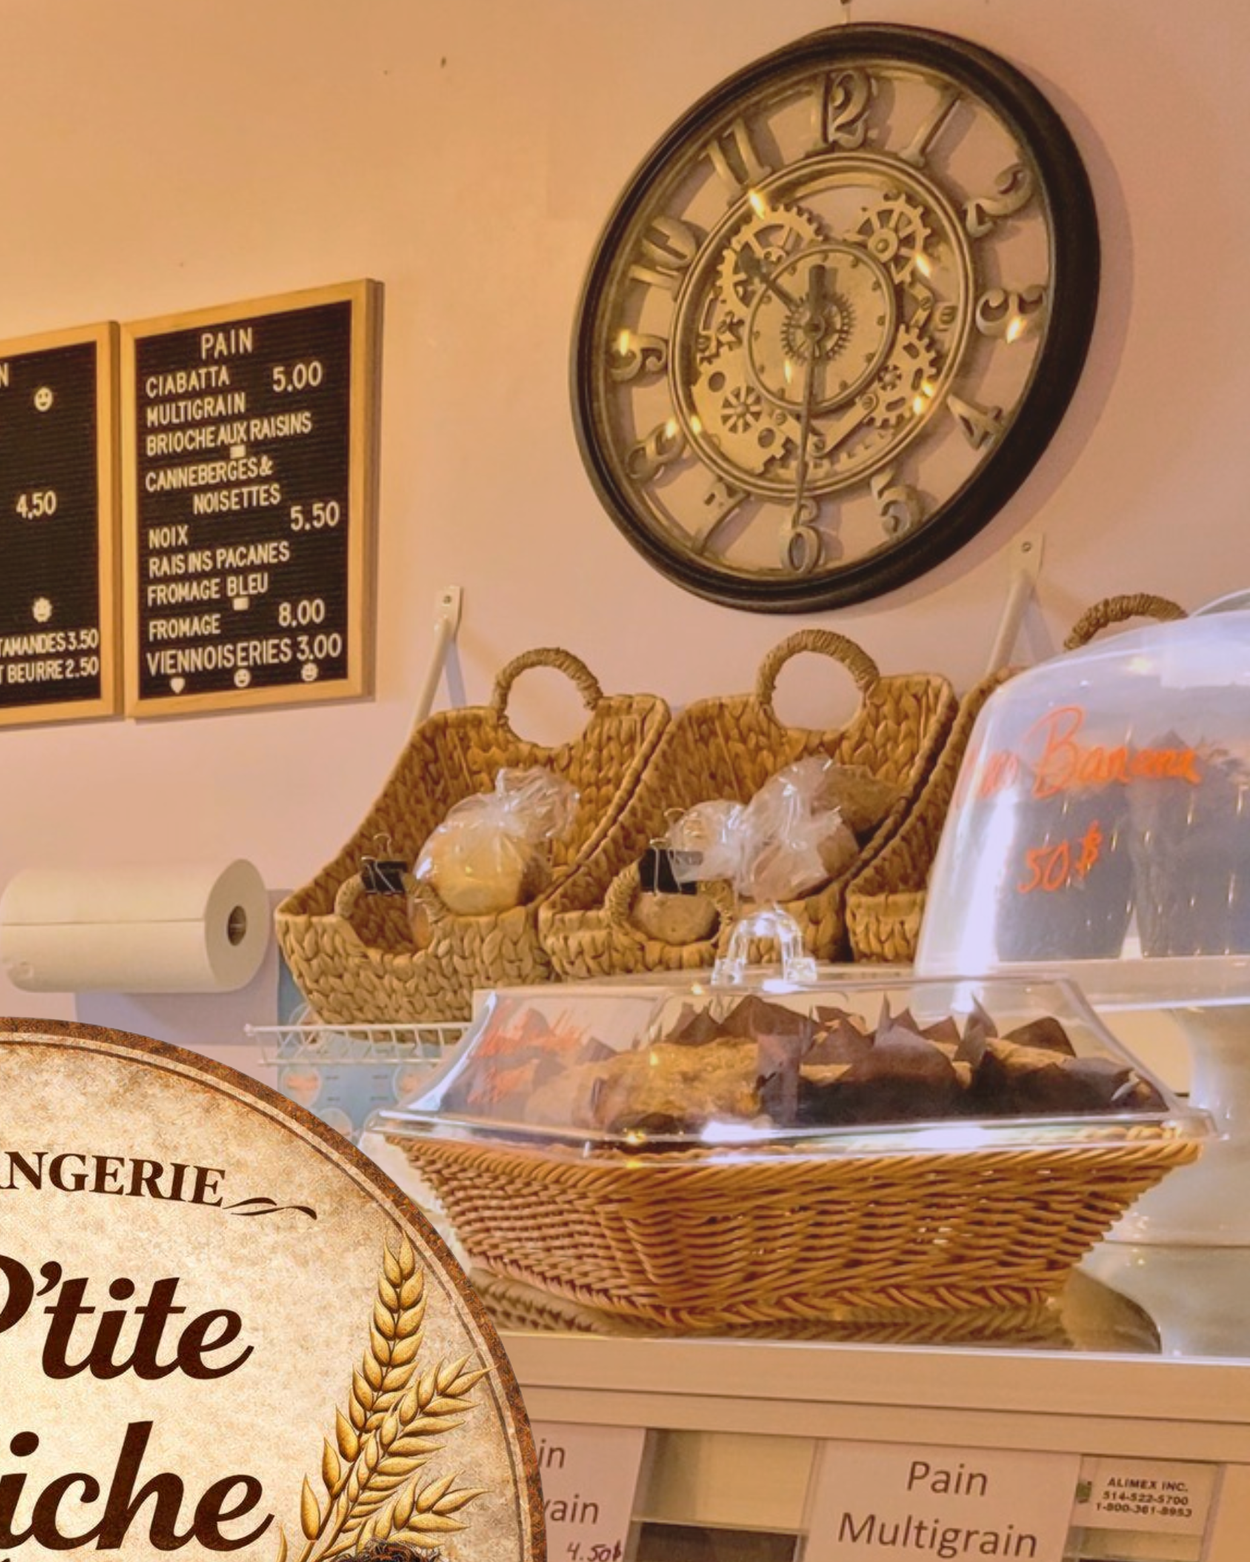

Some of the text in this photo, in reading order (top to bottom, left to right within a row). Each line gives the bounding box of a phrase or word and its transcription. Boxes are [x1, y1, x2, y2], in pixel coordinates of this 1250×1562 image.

[819, 69, 874, 151] 12
[900, 90, 961, 166] 1
[701, 118, 773, 194] 11
[964, 163, 1033, 238] 2
[630, 215, 698, 292] 10
[976, 283, 1048, 339] 3
[201, 327, 253, 360] PAIN
[608, 333, 669, 383] 9
[146, 365, 230, 398] CIABATTA
[272, 361, 323, 392] 5.00
[147, 392, 246, 428] MULTIGRAIN
[250, 411, 312, 441] RAISINS
[947, 393, 1005, 450] 4
[626, 420, 687, 481] 8
[193, 483, 281, 515] NOISETTES
[290, 501, 340, 531] 5.50
[693, 476, 750, 555] 7
[870, 469, 924, 539] 5
[149, 525, 189, 549] NOIX
[216, 541, 290, 569] PACANES
[781, 497, 822, 577] 6
[147, 572, 268, 607] FROMAGE BLEU
[149, 614, 221, 642] FROMAGE
[278, 598, 325, 627] 8.00
[67, 628, 99, 651] 3.50
[146, 633, 342, 676] VIENNOISERIES 3.00
[7, 660, 63, 684] BEURRE
[65, 656, 99, 679] 2.50
[905, 1459, 989, 1499] Pain
[1107, 1477, 1189, 1493] ALIMEX INC.
[836, 1510, 1039, 1560] Multigrain
